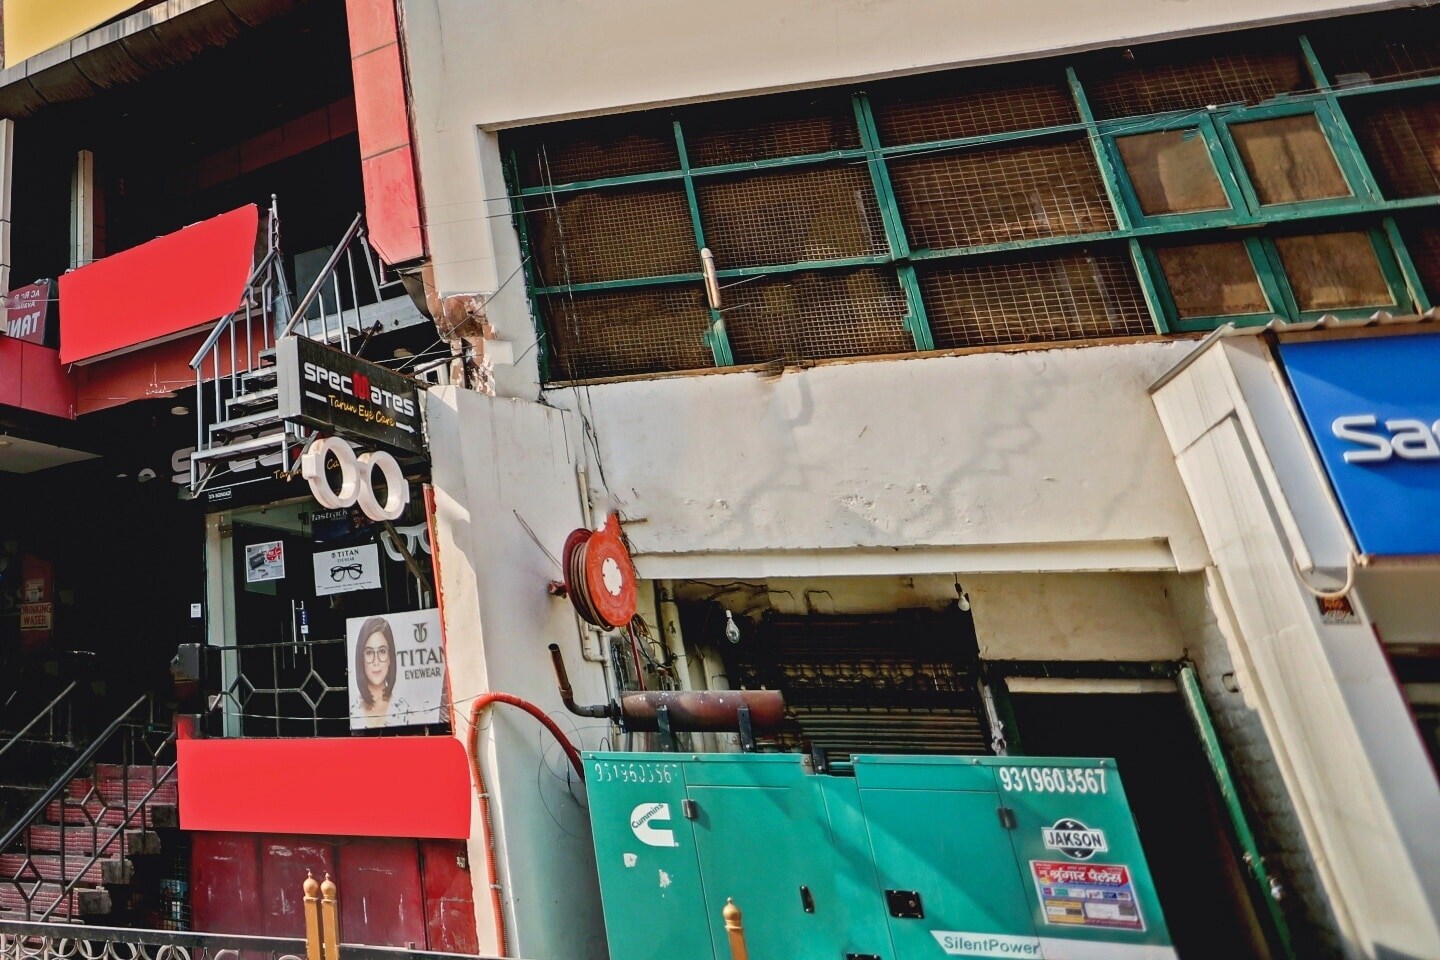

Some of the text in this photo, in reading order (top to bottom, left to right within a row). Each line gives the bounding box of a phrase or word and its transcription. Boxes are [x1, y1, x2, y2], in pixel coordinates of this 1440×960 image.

[328, 394, 395, 427] Tarun Eye Care
[1331, 413, 1440, 464] Sa
[337, 548, 359, 558] TITAN
[20, 603, 52, 614] DRINKING
[23, 615, 46, 625] WATER
[404, 667, 441, 680] EYEWEAR
[999, 767, 1106, 794] 9319603567
[632, 803, 664, 829] Cummins
[1047, 831, 1103, 848] JAKSON
[944, 936, 1040, 954] SilentPower
